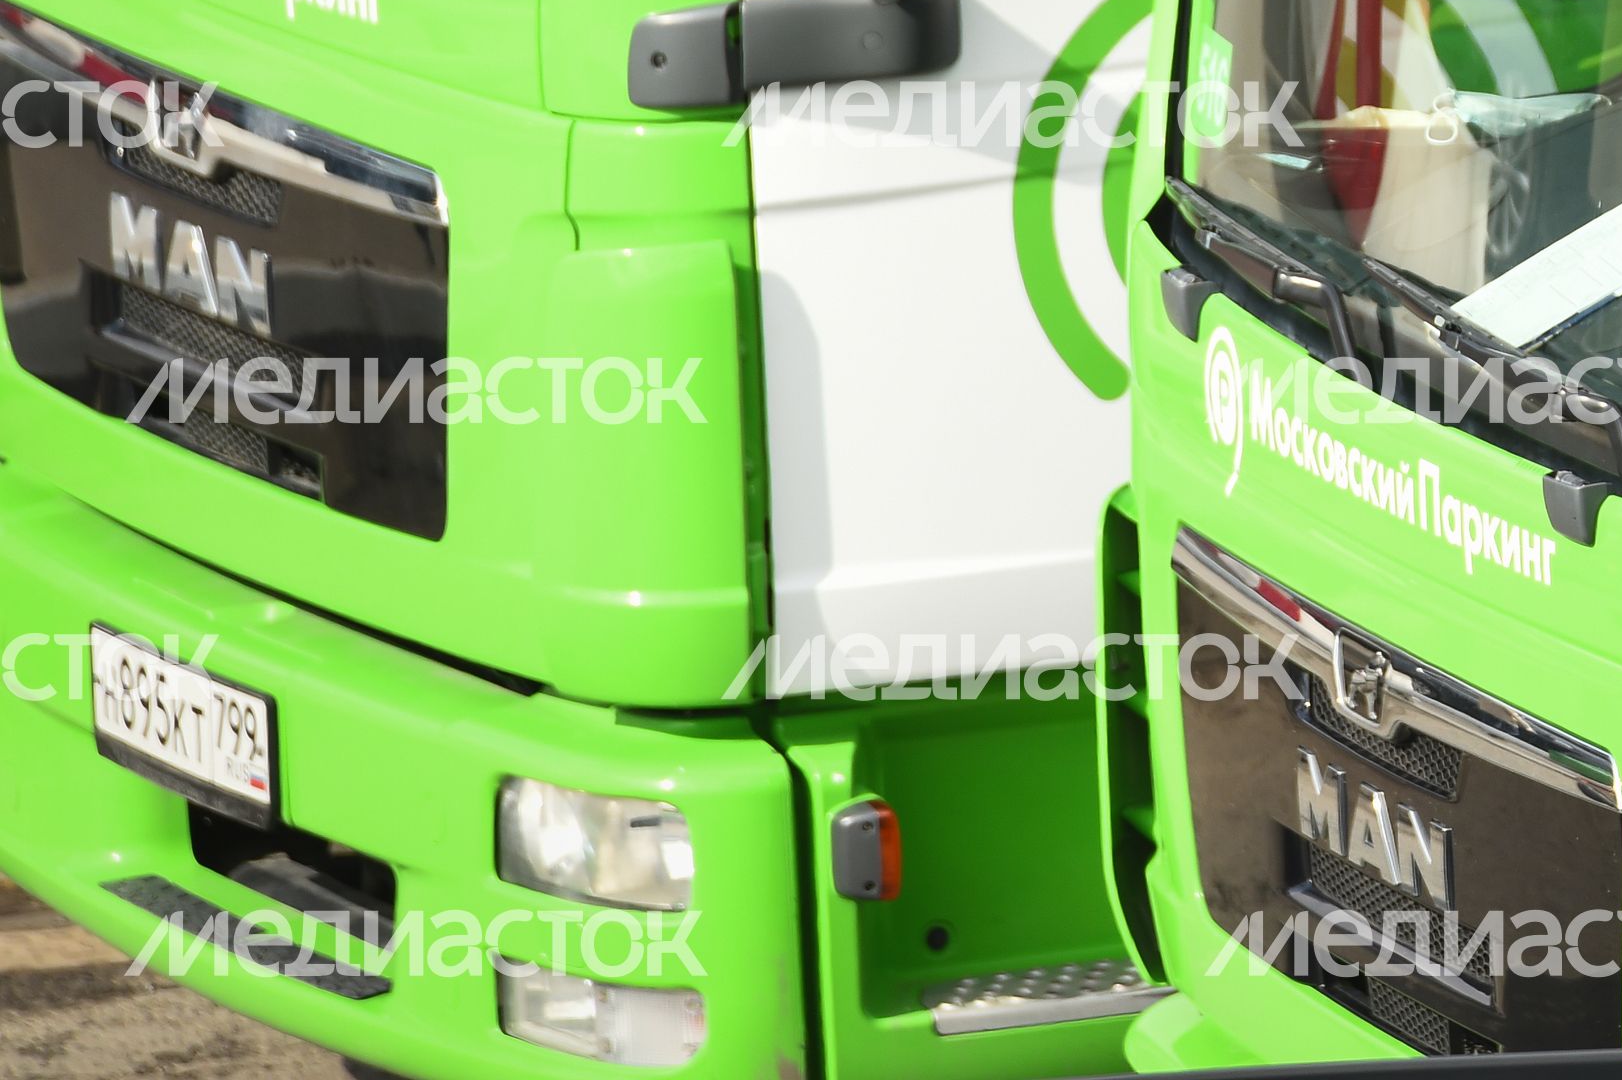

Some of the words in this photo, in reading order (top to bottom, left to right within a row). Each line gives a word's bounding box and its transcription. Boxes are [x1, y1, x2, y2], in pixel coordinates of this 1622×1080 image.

[110, 191, 274, 337] MAN
[1250, 369, 1416, 525] Московский
[1417, 457, 1556, 586] Паркинг
[213, 693, 257, 761] 799
[1296, 745, 1457, 913] MAN
